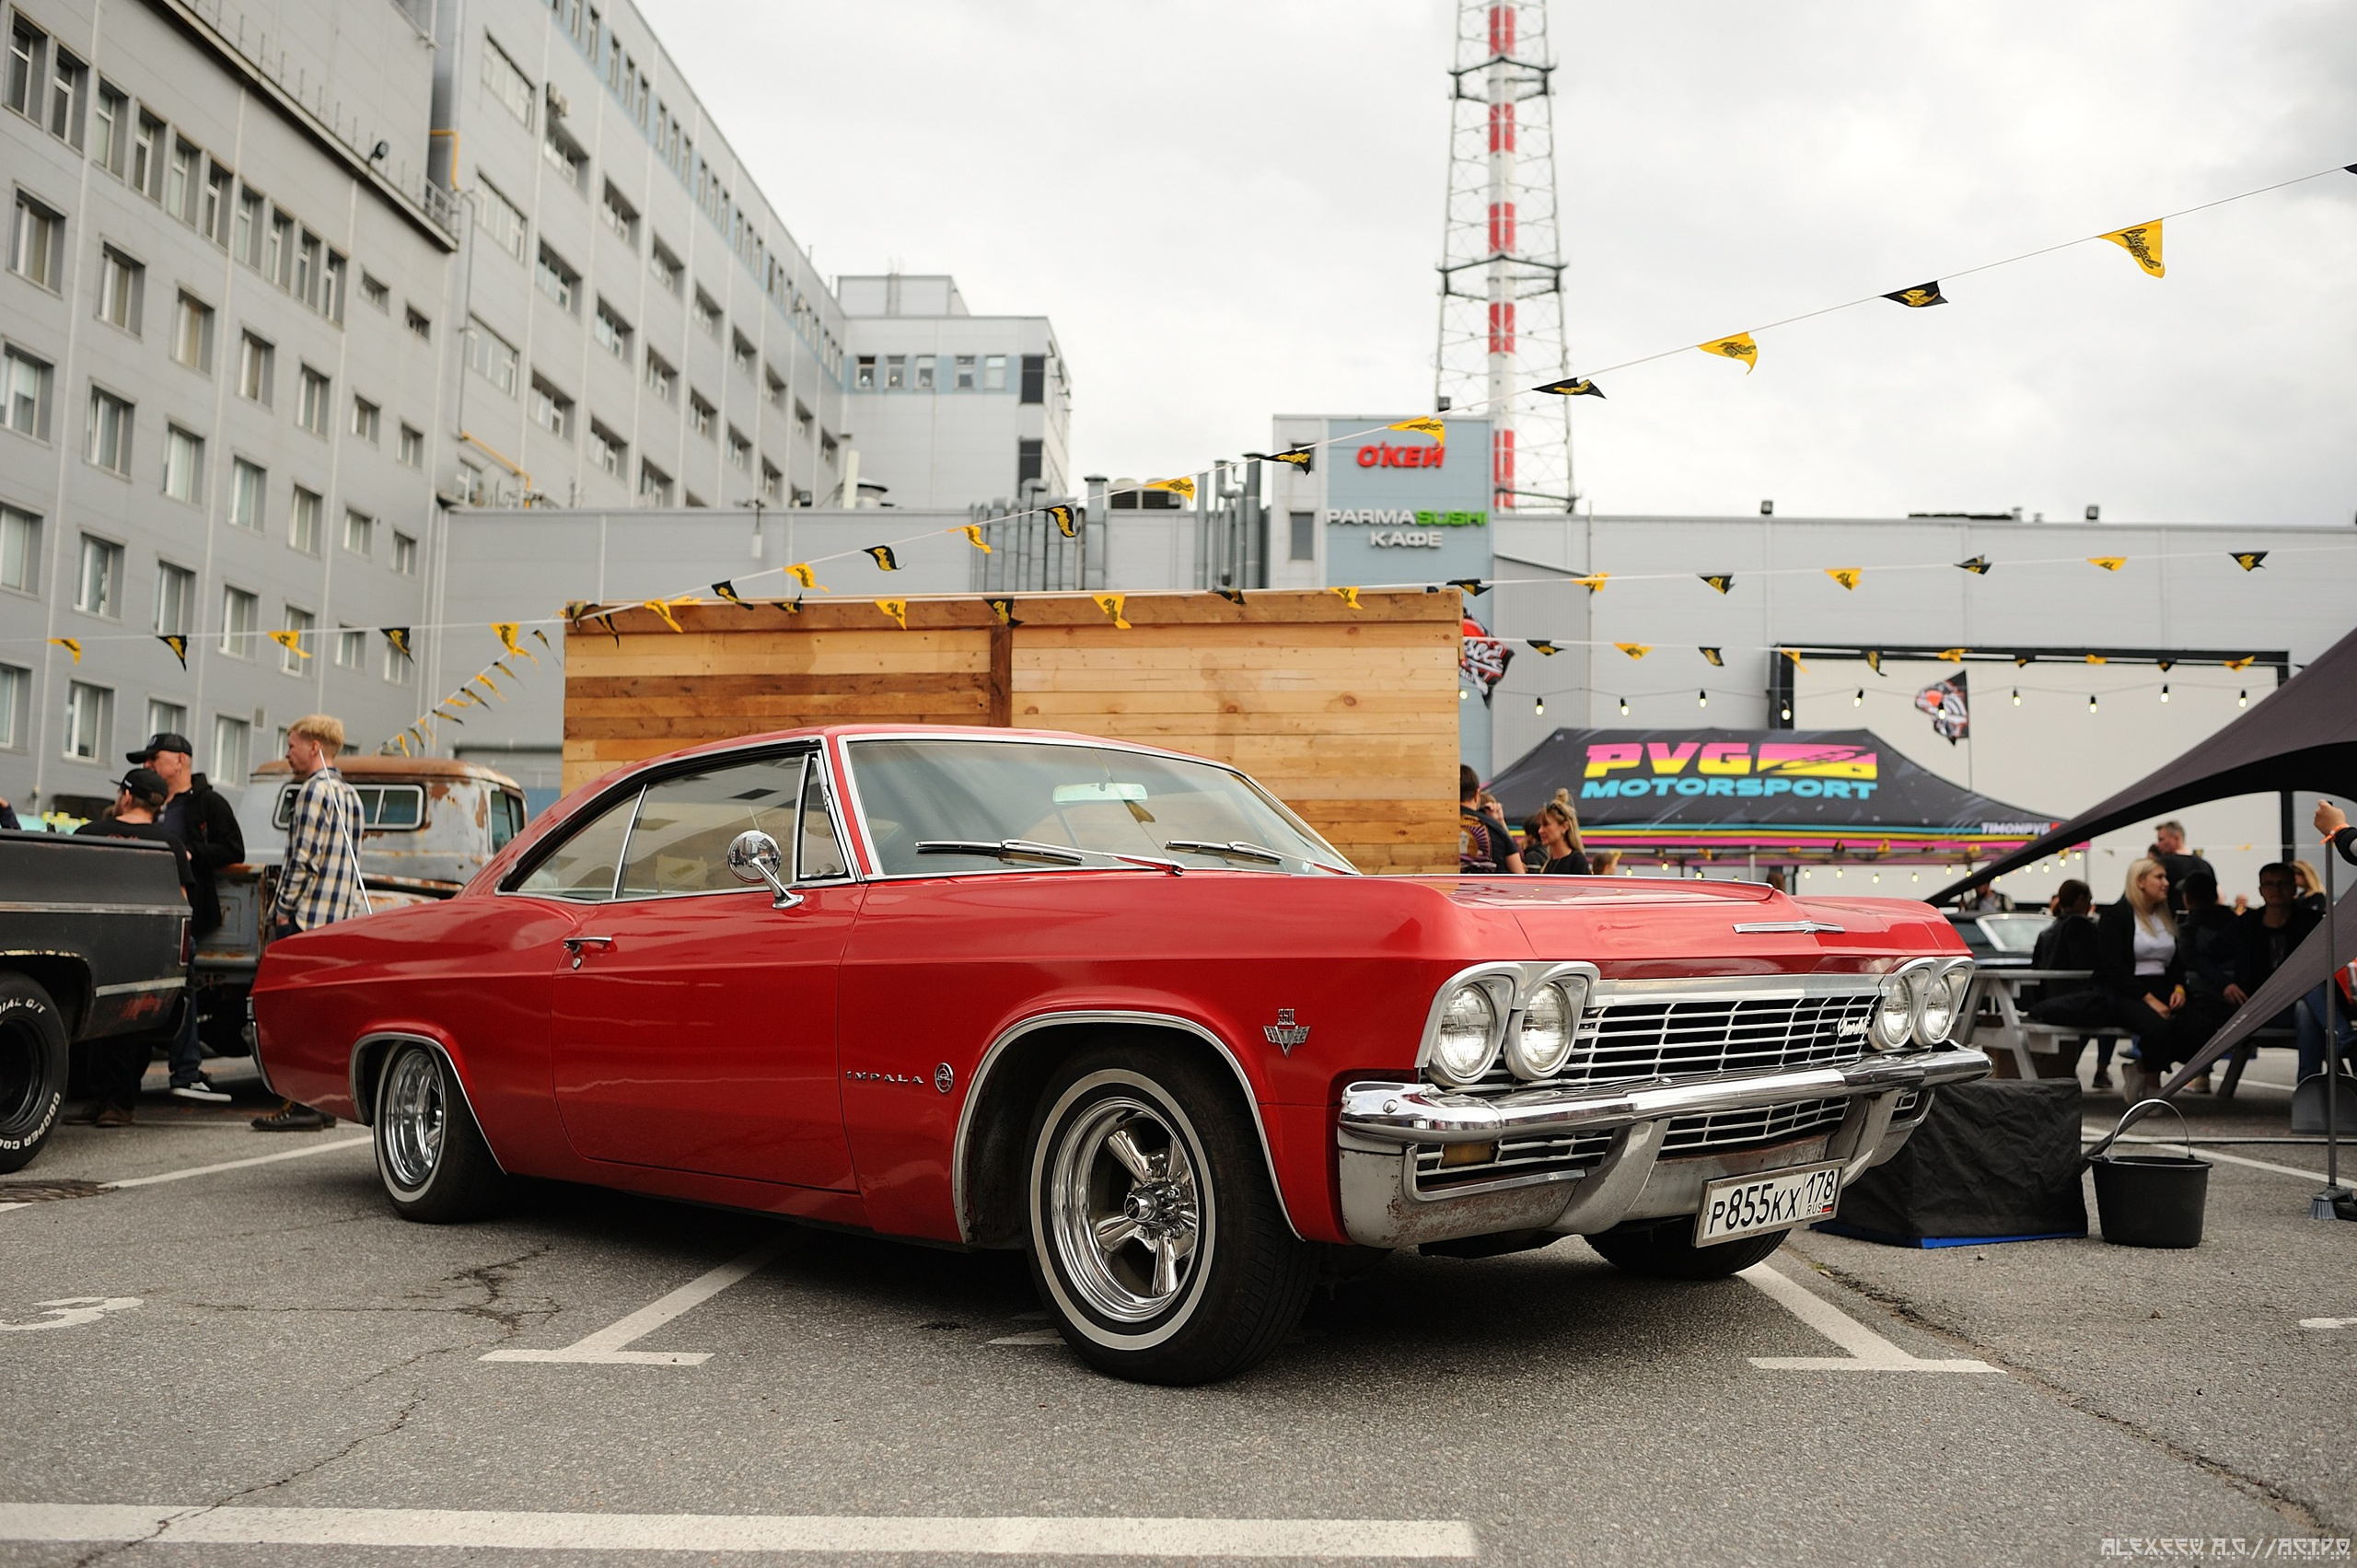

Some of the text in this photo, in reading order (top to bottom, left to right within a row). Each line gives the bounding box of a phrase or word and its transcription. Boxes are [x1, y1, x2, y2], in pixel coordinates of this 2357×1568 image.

[1326, 509, 1488, 527] PARMASUSHI
[1370, 531, 1444, 548] КАФЕ
[1584, 742, 1752, 778] PVG
[1581, 778, 1878, 799] MOTORSPORT
[846, 1071, 924, 1084] IMPALA
[24, 1092, 61, 1147] COOPER
[1709, 1169, 1835, 1234] P855KX 178
[1806, 1202, 1823, 1215] RUS
